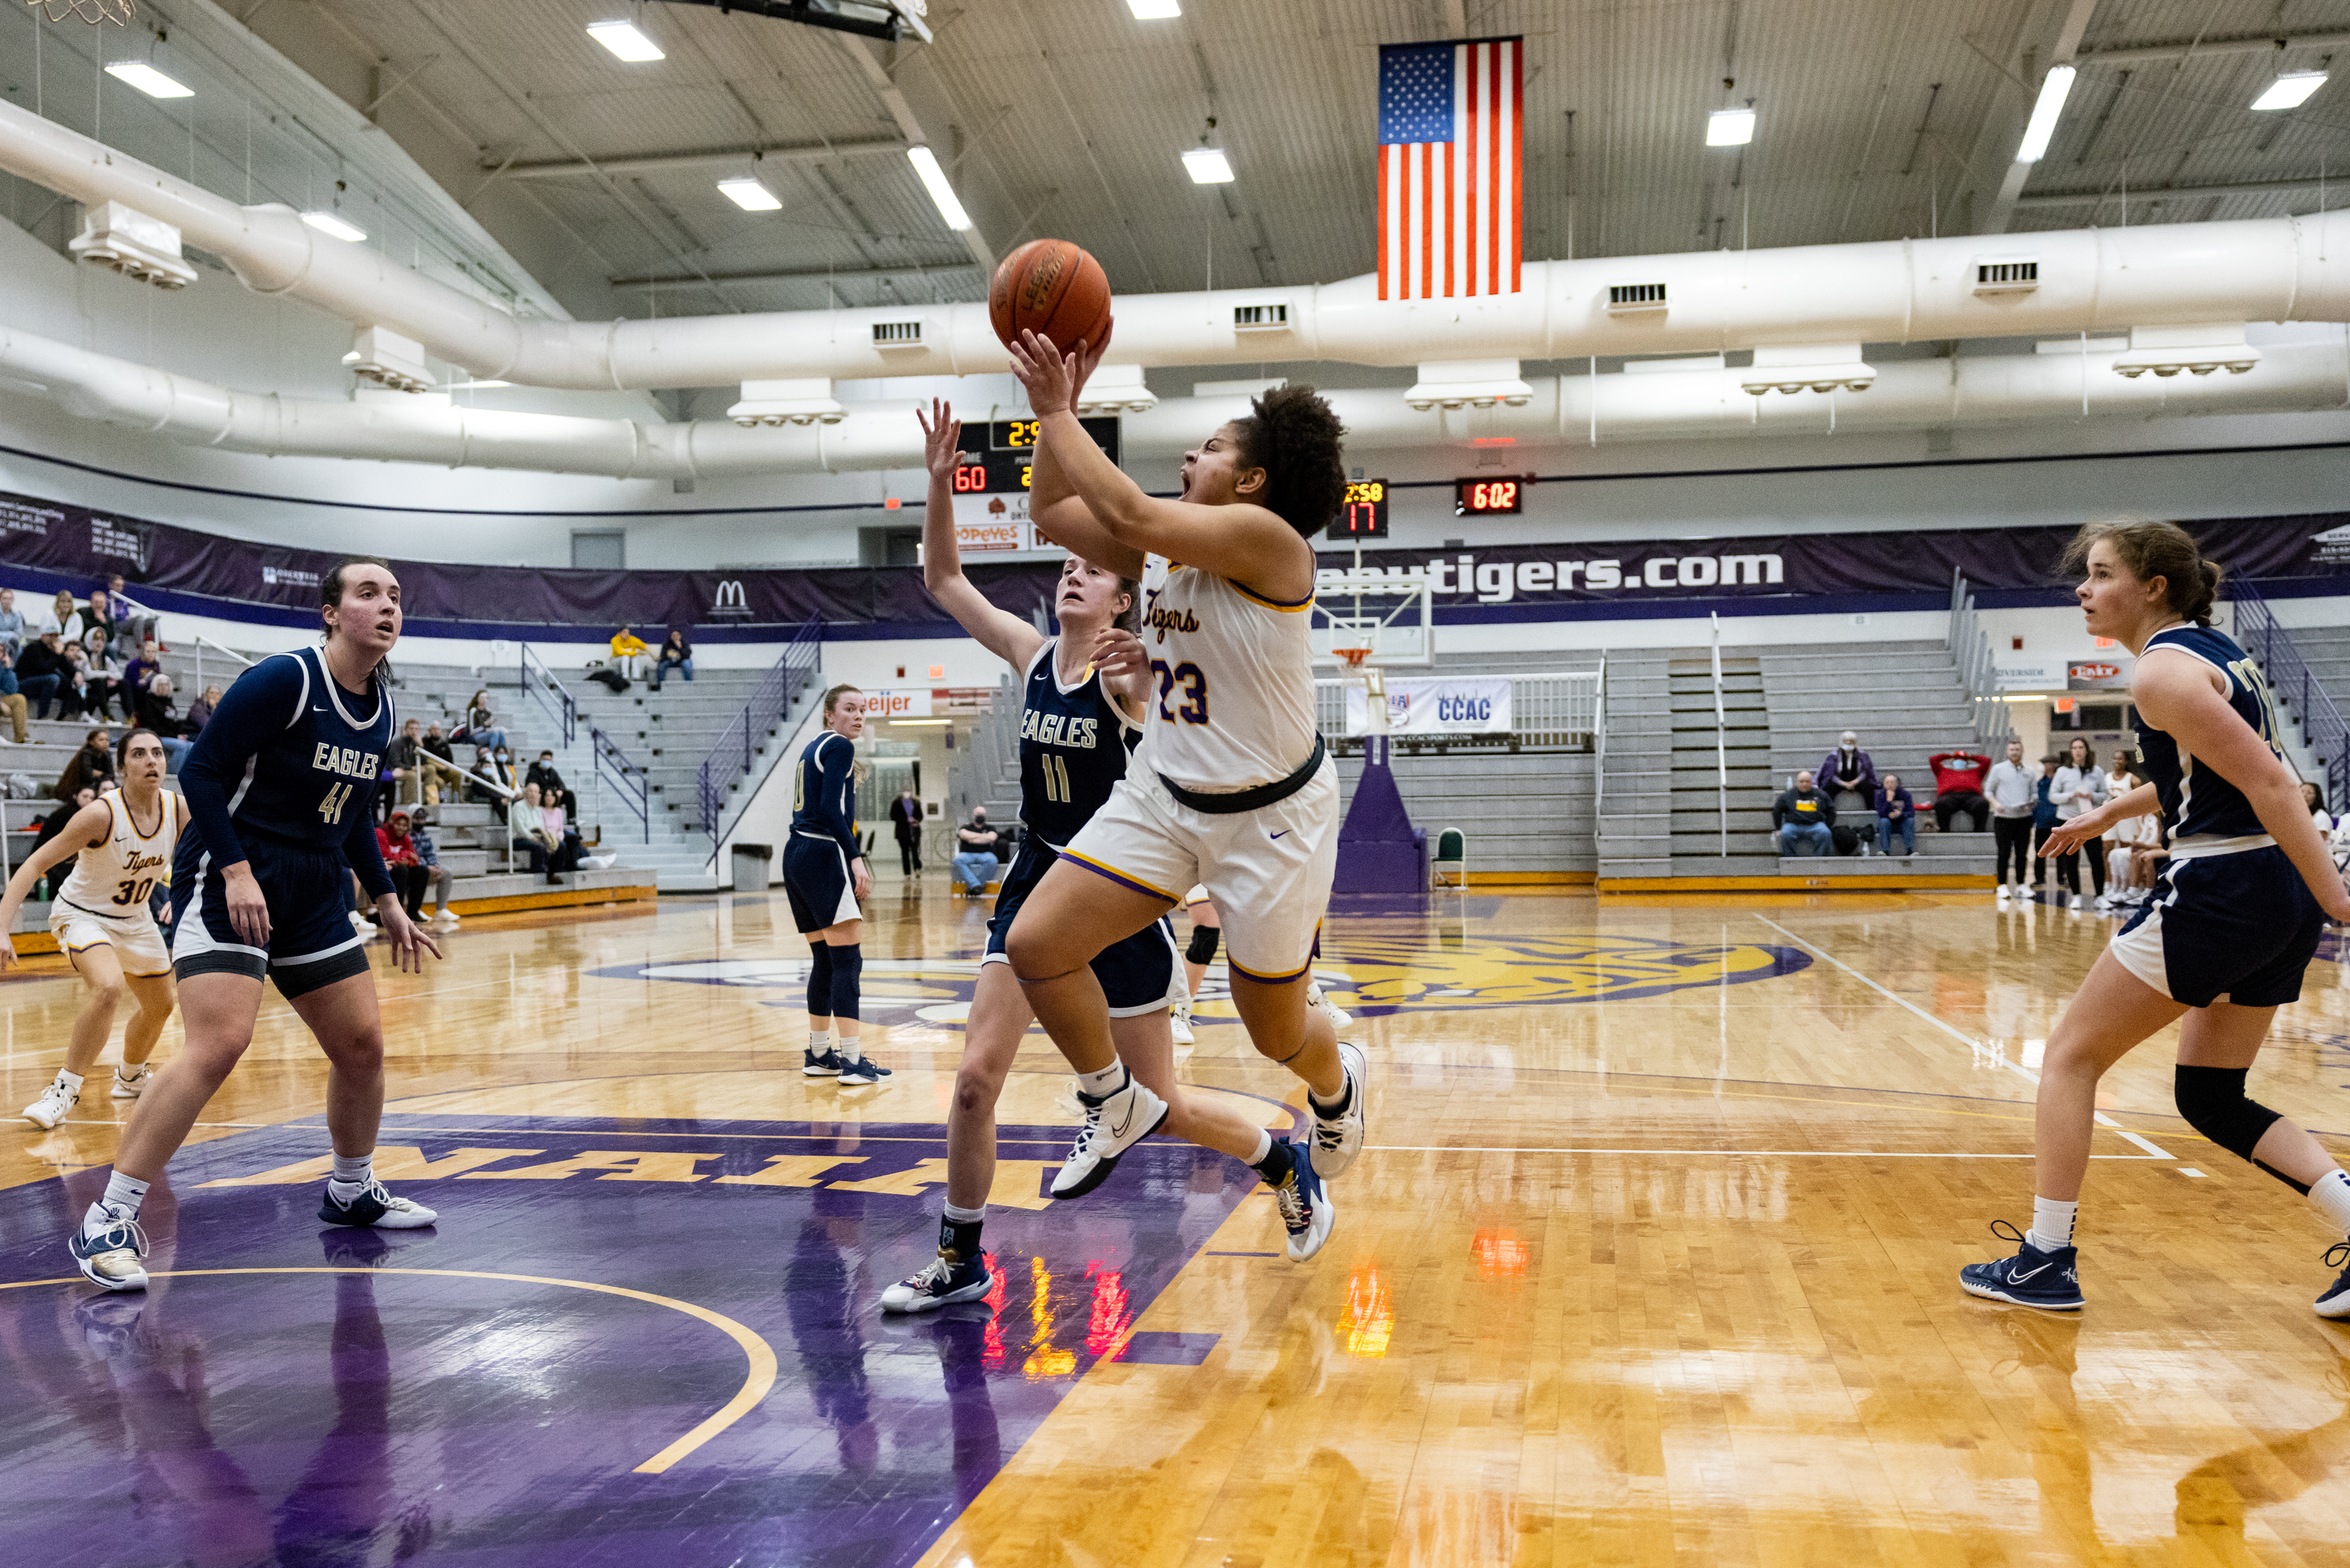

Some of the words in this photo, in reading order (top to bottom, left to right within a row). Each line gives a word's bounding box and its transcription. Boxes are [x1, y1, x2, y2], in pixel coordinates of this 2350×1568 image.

[955, 466, 987, 492] 60
[1344, 483, 1383, 503] 2:58
[1350, 502, 1375, 531] 17
[1142, 588, 1200, 645] Tigers
[1150, 657, 1210, 726] 23
[1438, 698, 1492, 721] CCAC
[1020, 708, 1098, 750] EAGLES
[312, 742, 379, 781] EAGLES
[1042, 753, 1071, 803] 11
[317, 781, 353, 825] 41
[122, 850, 165, 875] Tigers
[111, 877, 155, 906] 30
